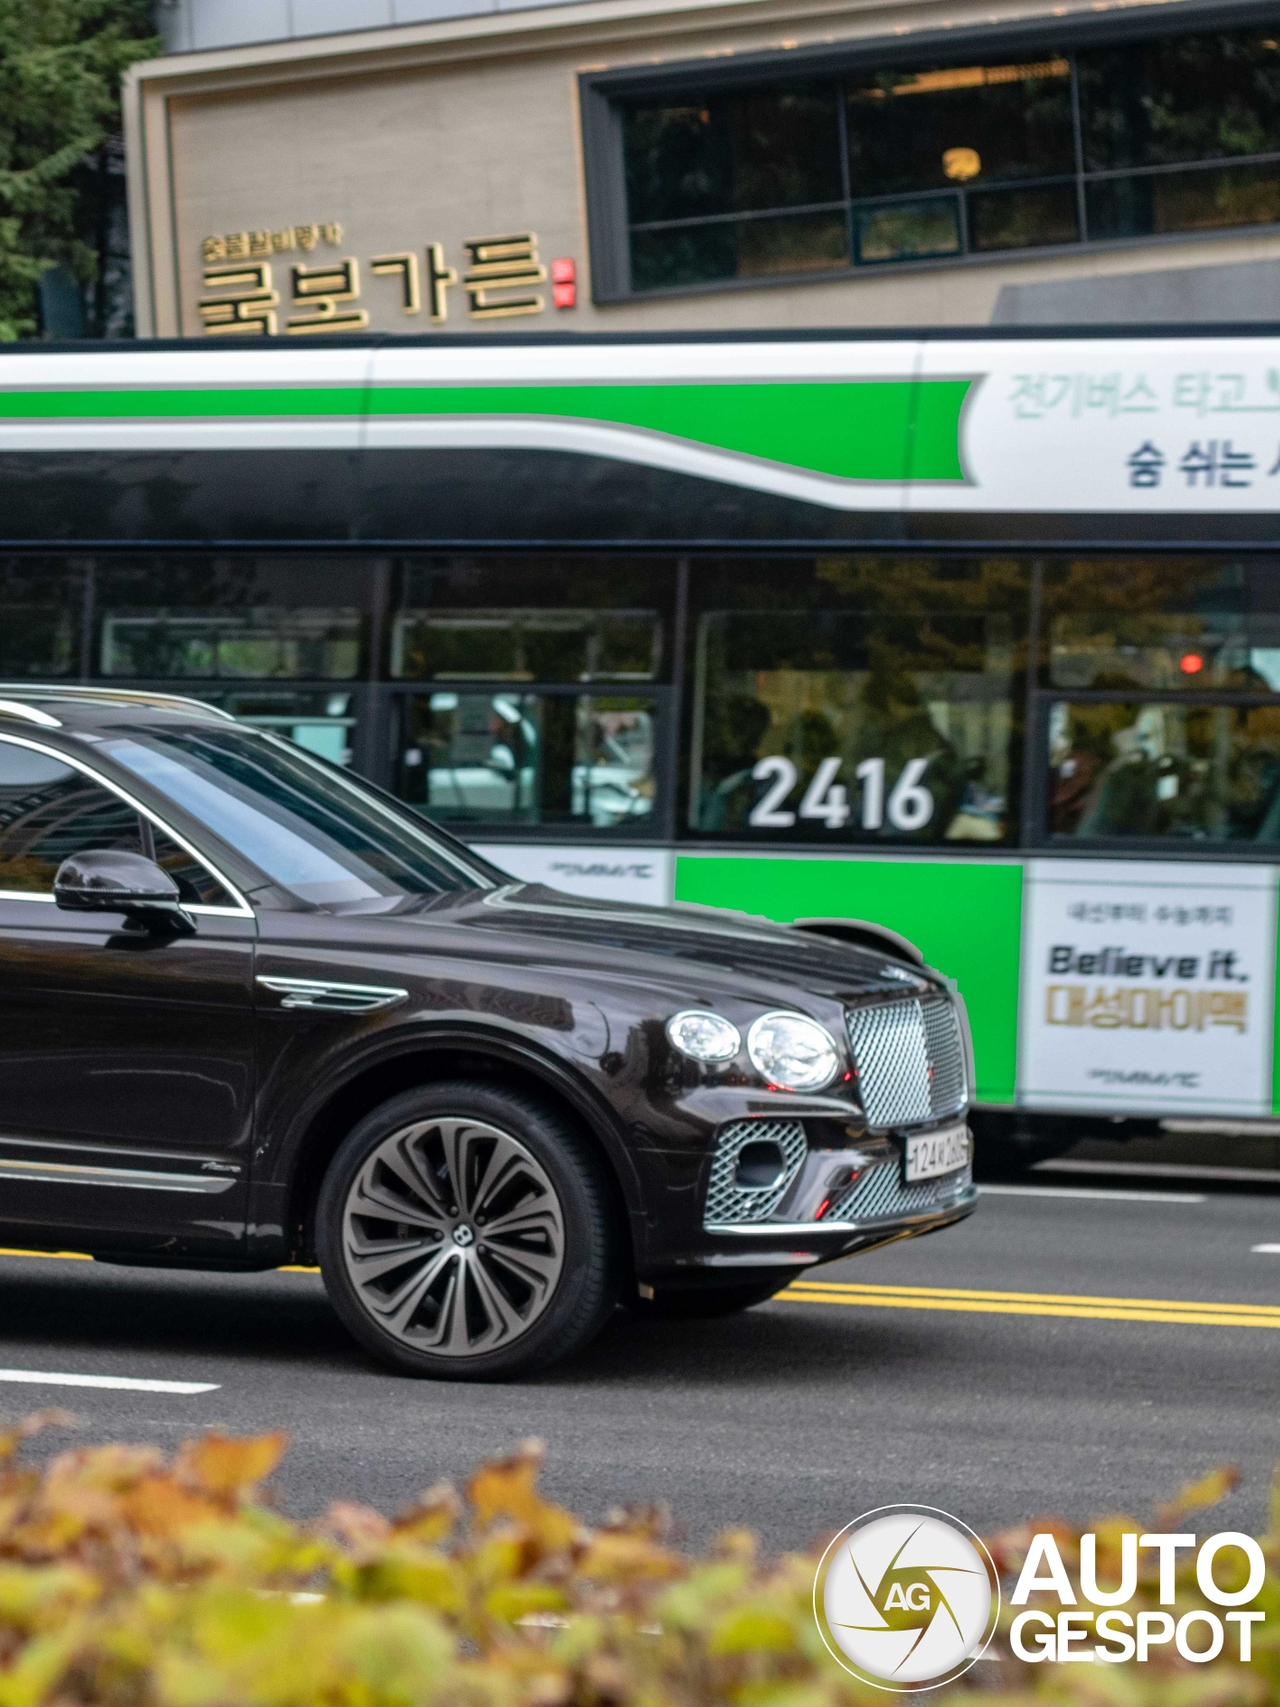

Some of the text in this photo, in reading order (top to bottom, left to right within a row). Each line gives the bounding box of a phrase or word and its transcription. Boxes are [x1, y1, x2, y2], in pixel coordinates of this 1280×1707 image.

[199, 231, 548, 336] 국보가든
[1008, 370, 1160, 420] 전기버스
[1126, 440, 1165, 489] 숨
[1178, 439, 1256, 489] 쉬는
[748, 755, 935, 830] 2416
[1046, 945, 1249, 983] Believe it.
